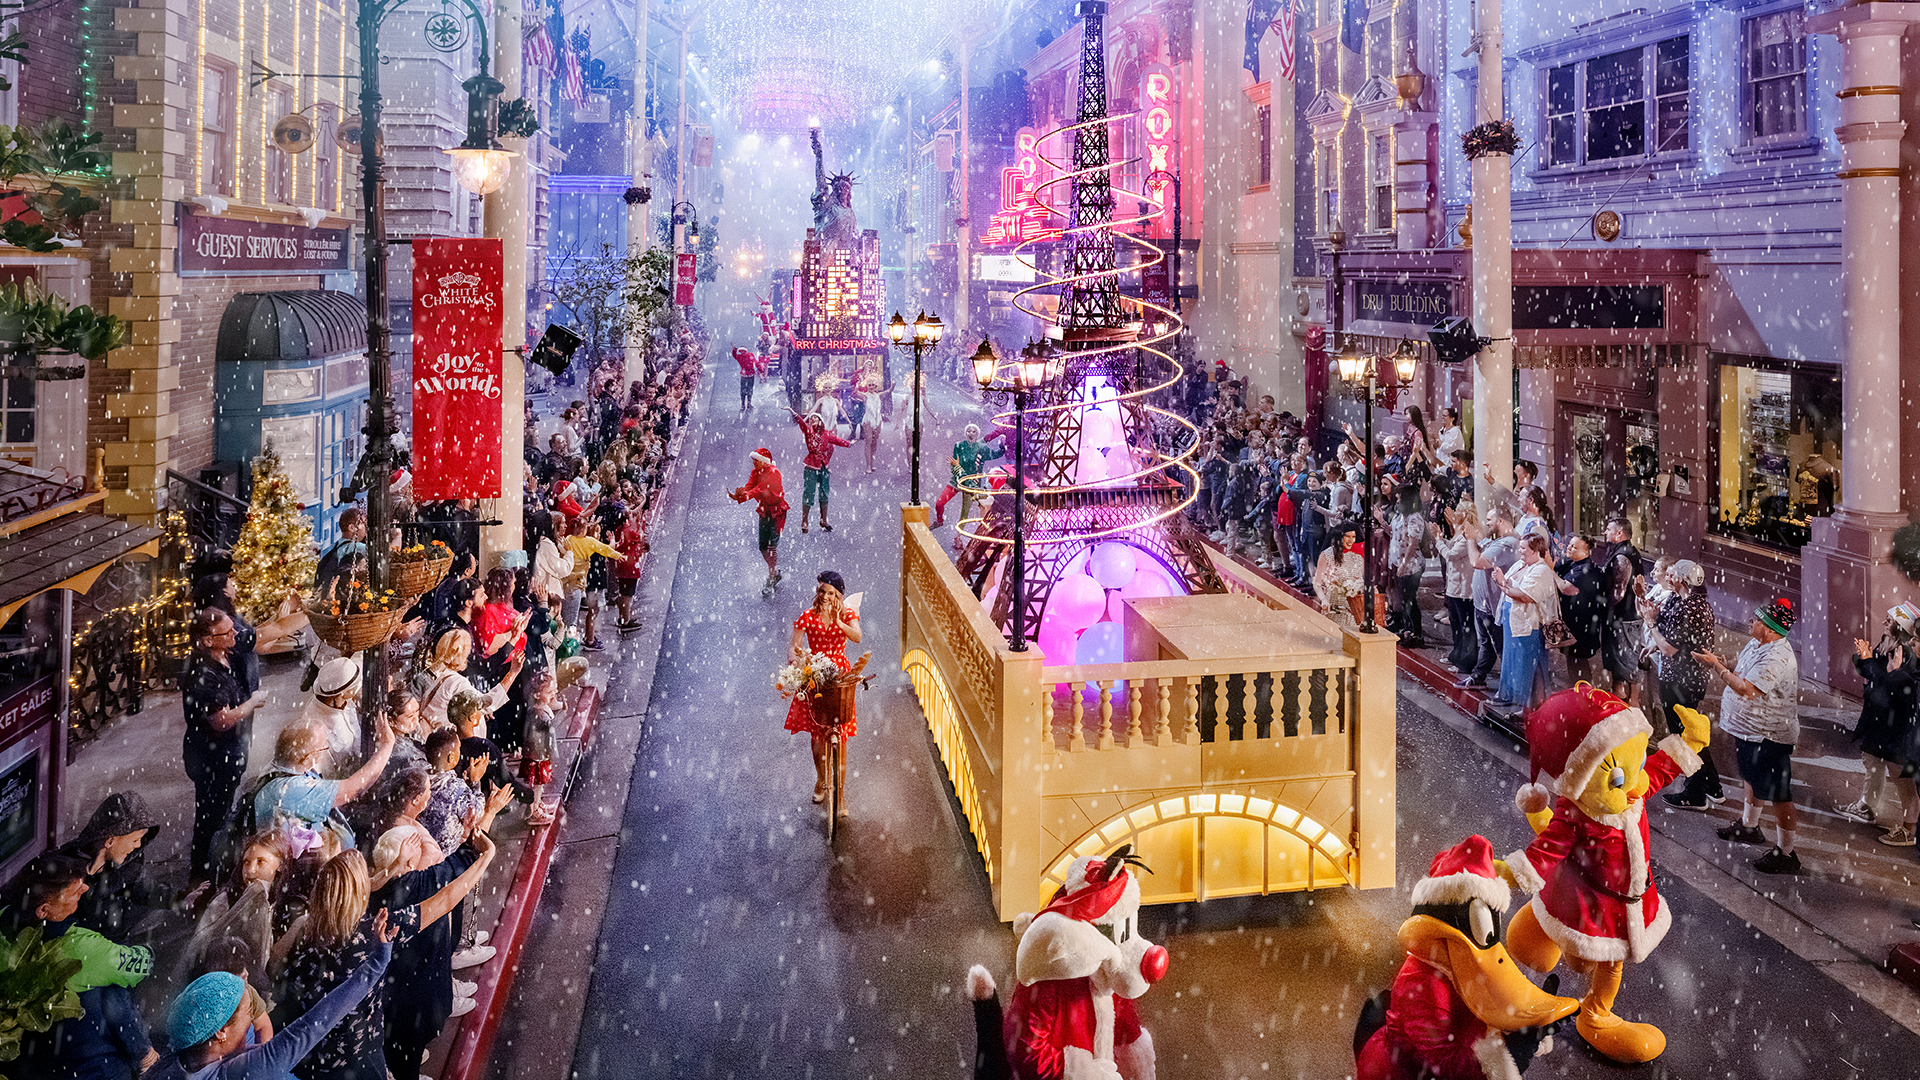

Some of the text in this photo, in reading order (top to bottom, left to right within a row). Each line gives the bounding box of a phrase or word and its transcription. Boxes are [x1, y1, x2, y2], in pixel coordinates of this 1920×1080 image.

[1146, 73, 1171, 206] ROXY
[198, 233, 298, 259] GUEST SERVICES
[303, 239, 341, 250] STROLLER HIRE
[303, 250, 317, 259] LOST
[321, 250, 339, 260] FOUND
[421, 292, 494, 308] CHRISTMAS
[438, 287, 479, 296] WHITE
[1362, 294, 1446, 314] DRU BUILDING
[796, 340, 877, 349] RRY CHRISTMAS
[433, 352, 480, 373] Joy
[414, 374, 501, 399] World
[20, 687, 53, 717] SALES
